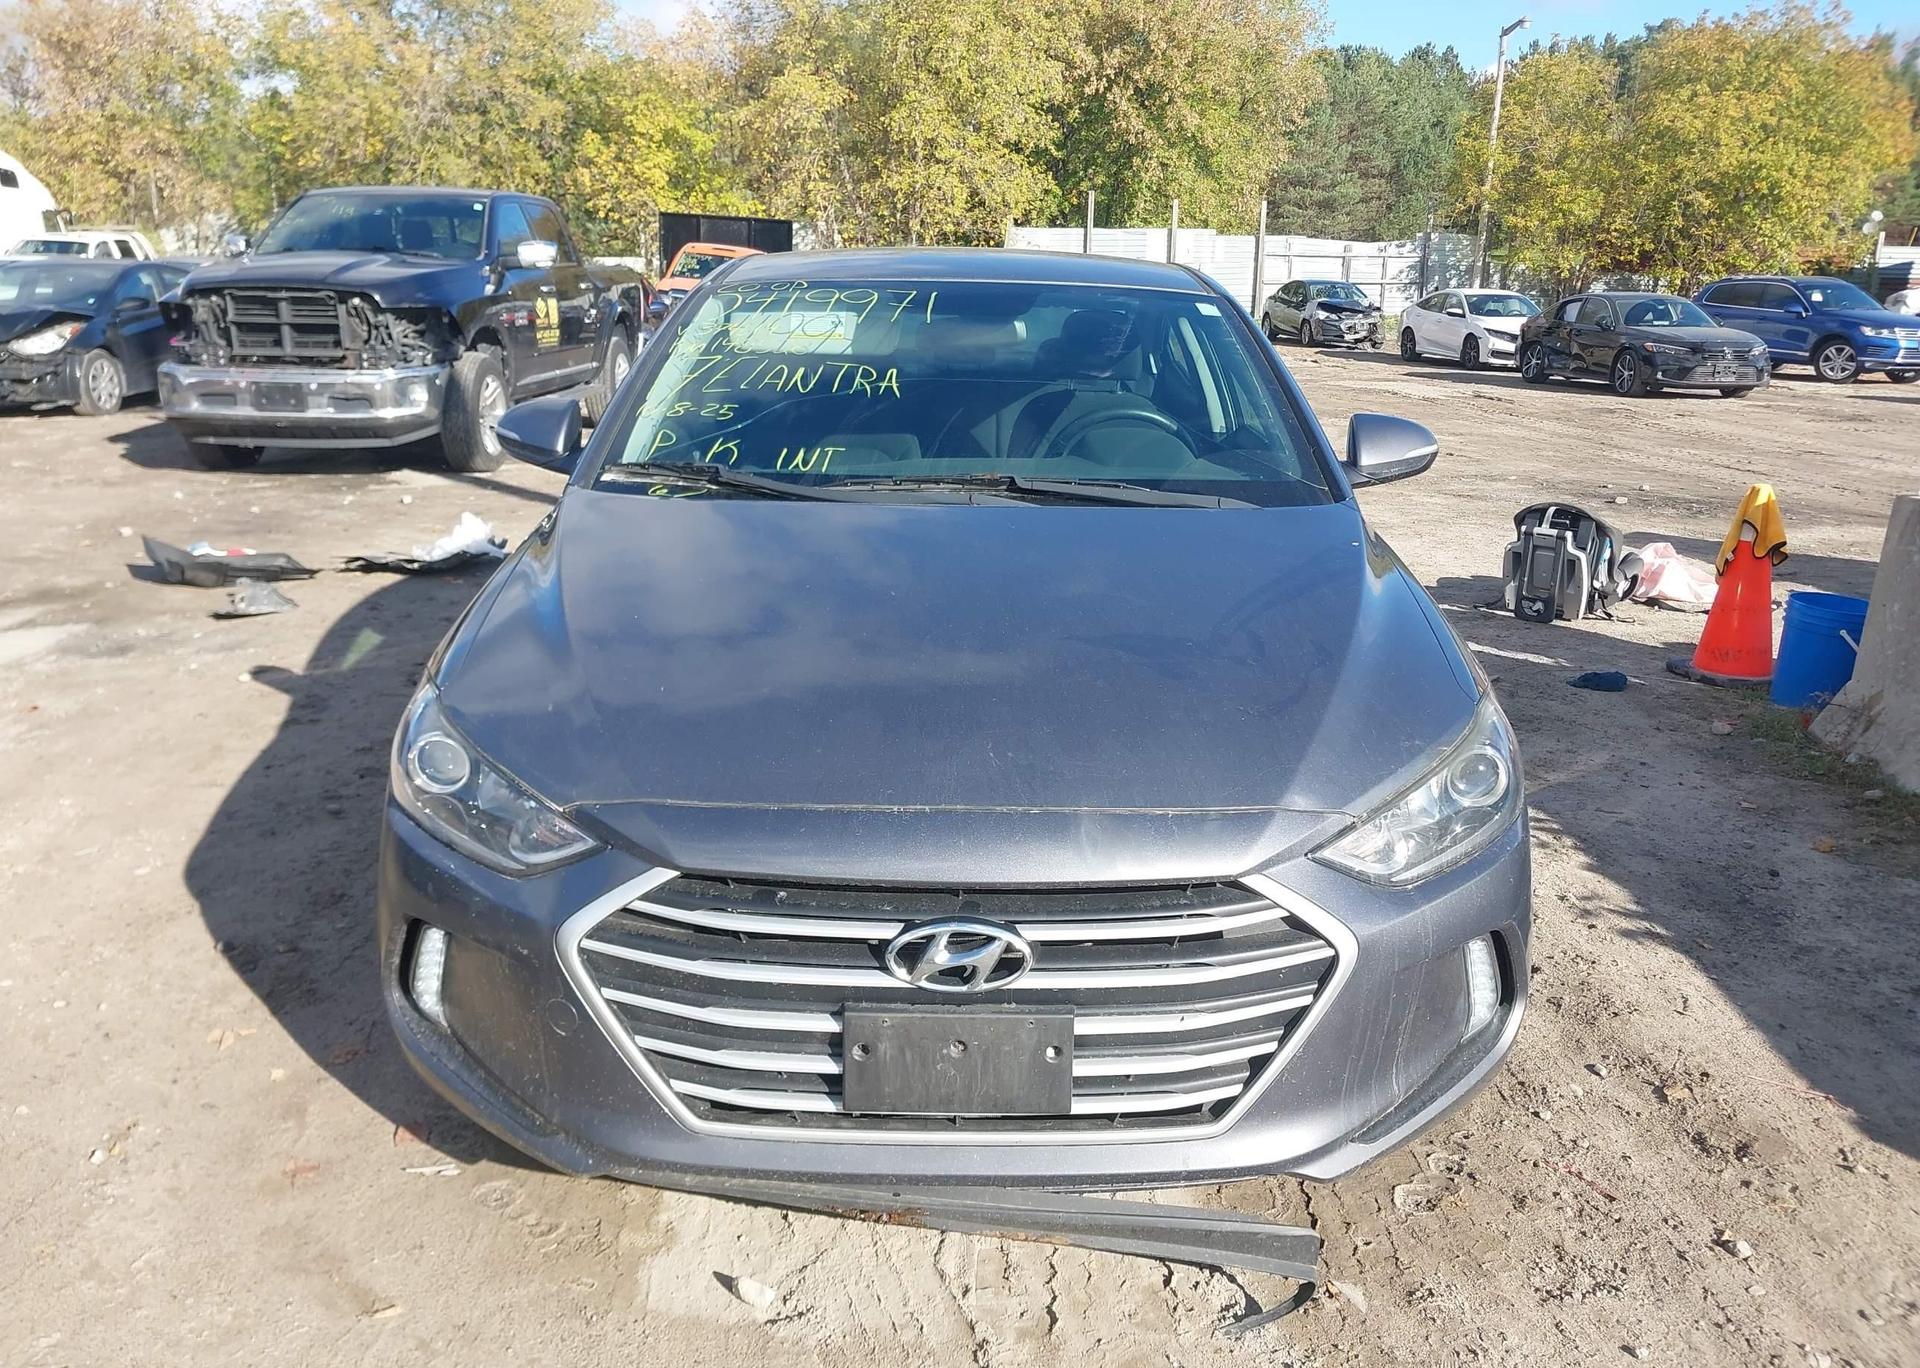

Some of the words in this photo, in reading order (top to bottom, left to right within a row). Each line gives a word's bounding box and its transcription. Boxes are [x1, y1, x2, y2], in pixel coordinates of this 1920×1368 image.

[645, 429, 677, 461] P
[705, 437, 741, 465] K
[775, 447, 846, 473] INT
